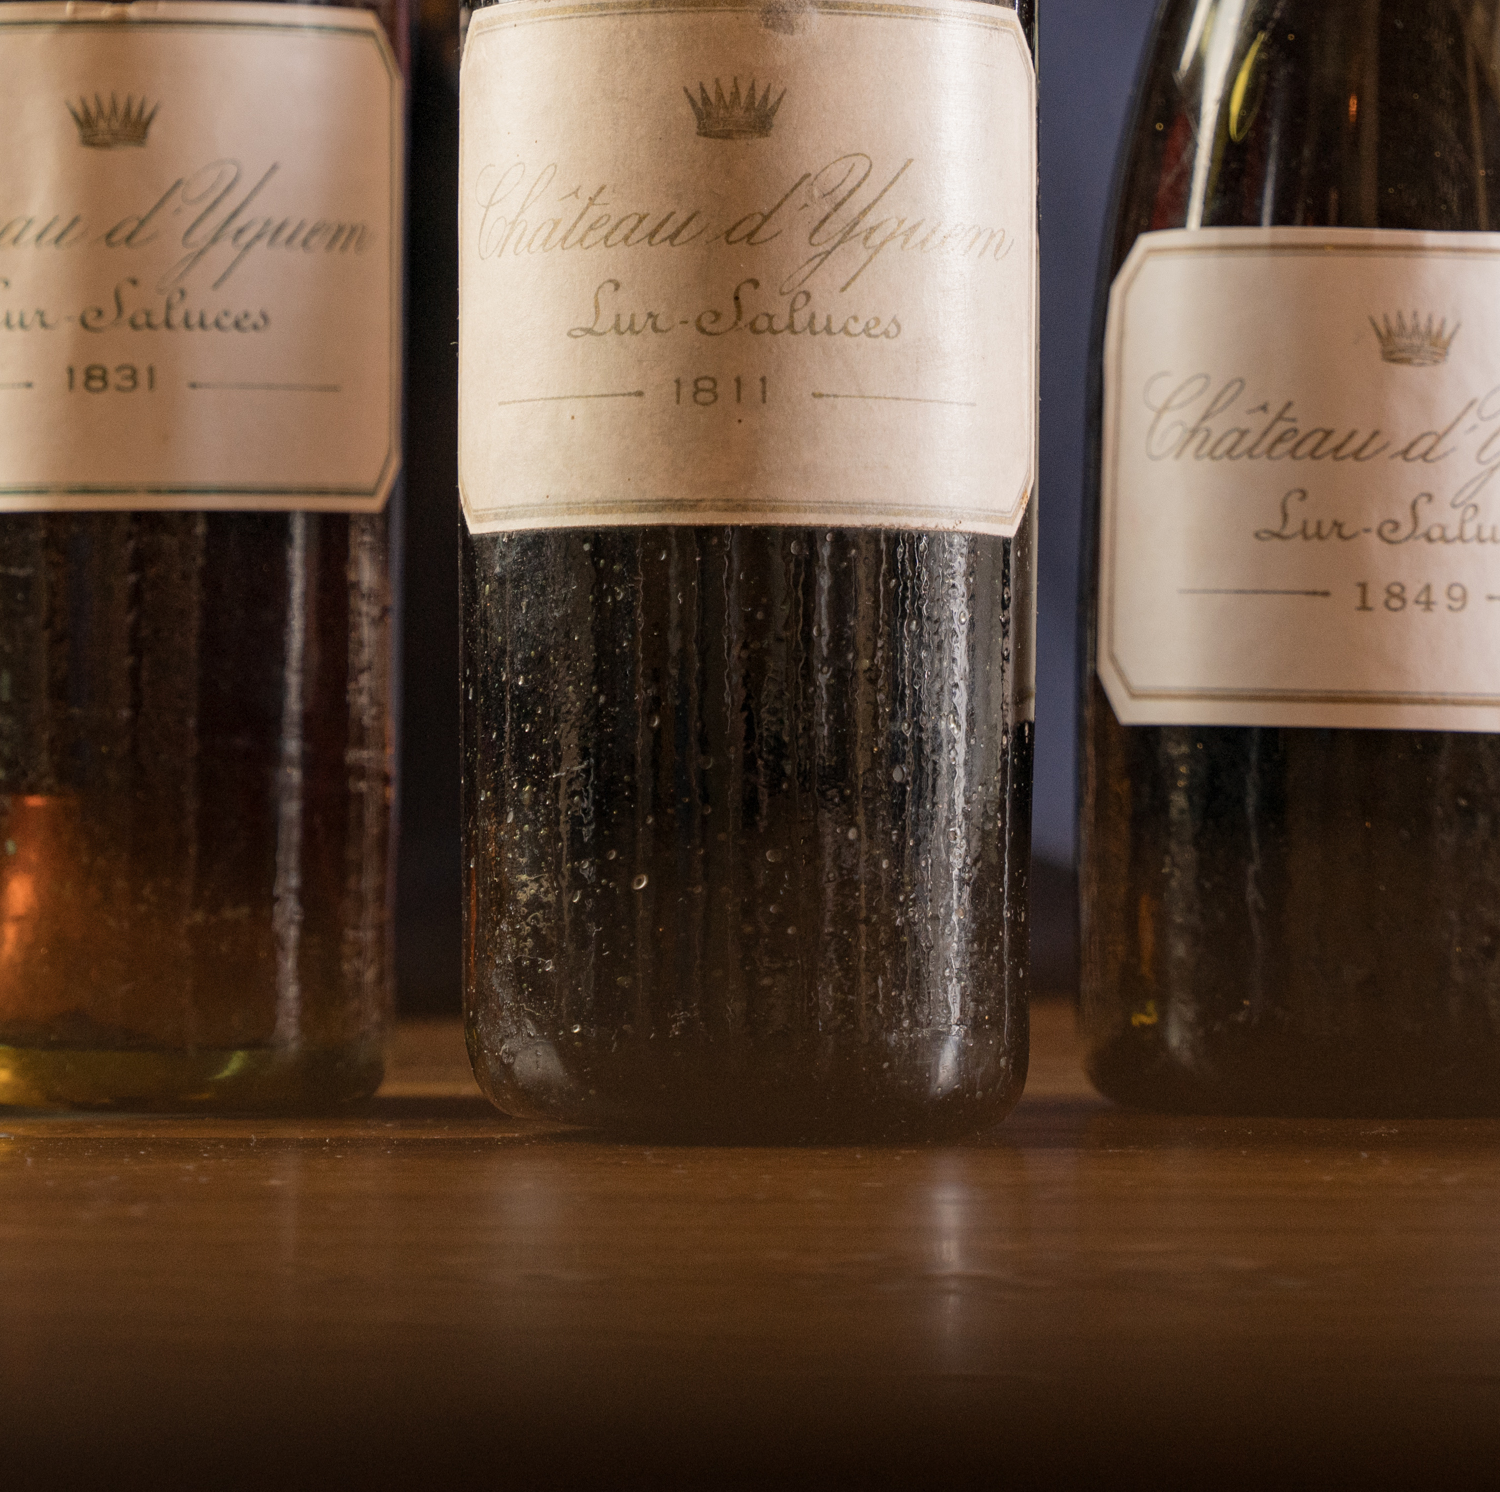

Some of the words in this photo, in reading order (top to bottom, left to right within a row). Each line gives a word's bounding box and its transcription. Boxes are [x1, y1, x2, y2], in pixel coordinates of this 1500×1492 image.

[476, 161, 708, 261] Château
[64, 362, 157, 394] 1831
[672, 376, 769, 406] 1811
[1143, 370, 1390, 462] Château
[1354, 581, 1470, 613] 1849
